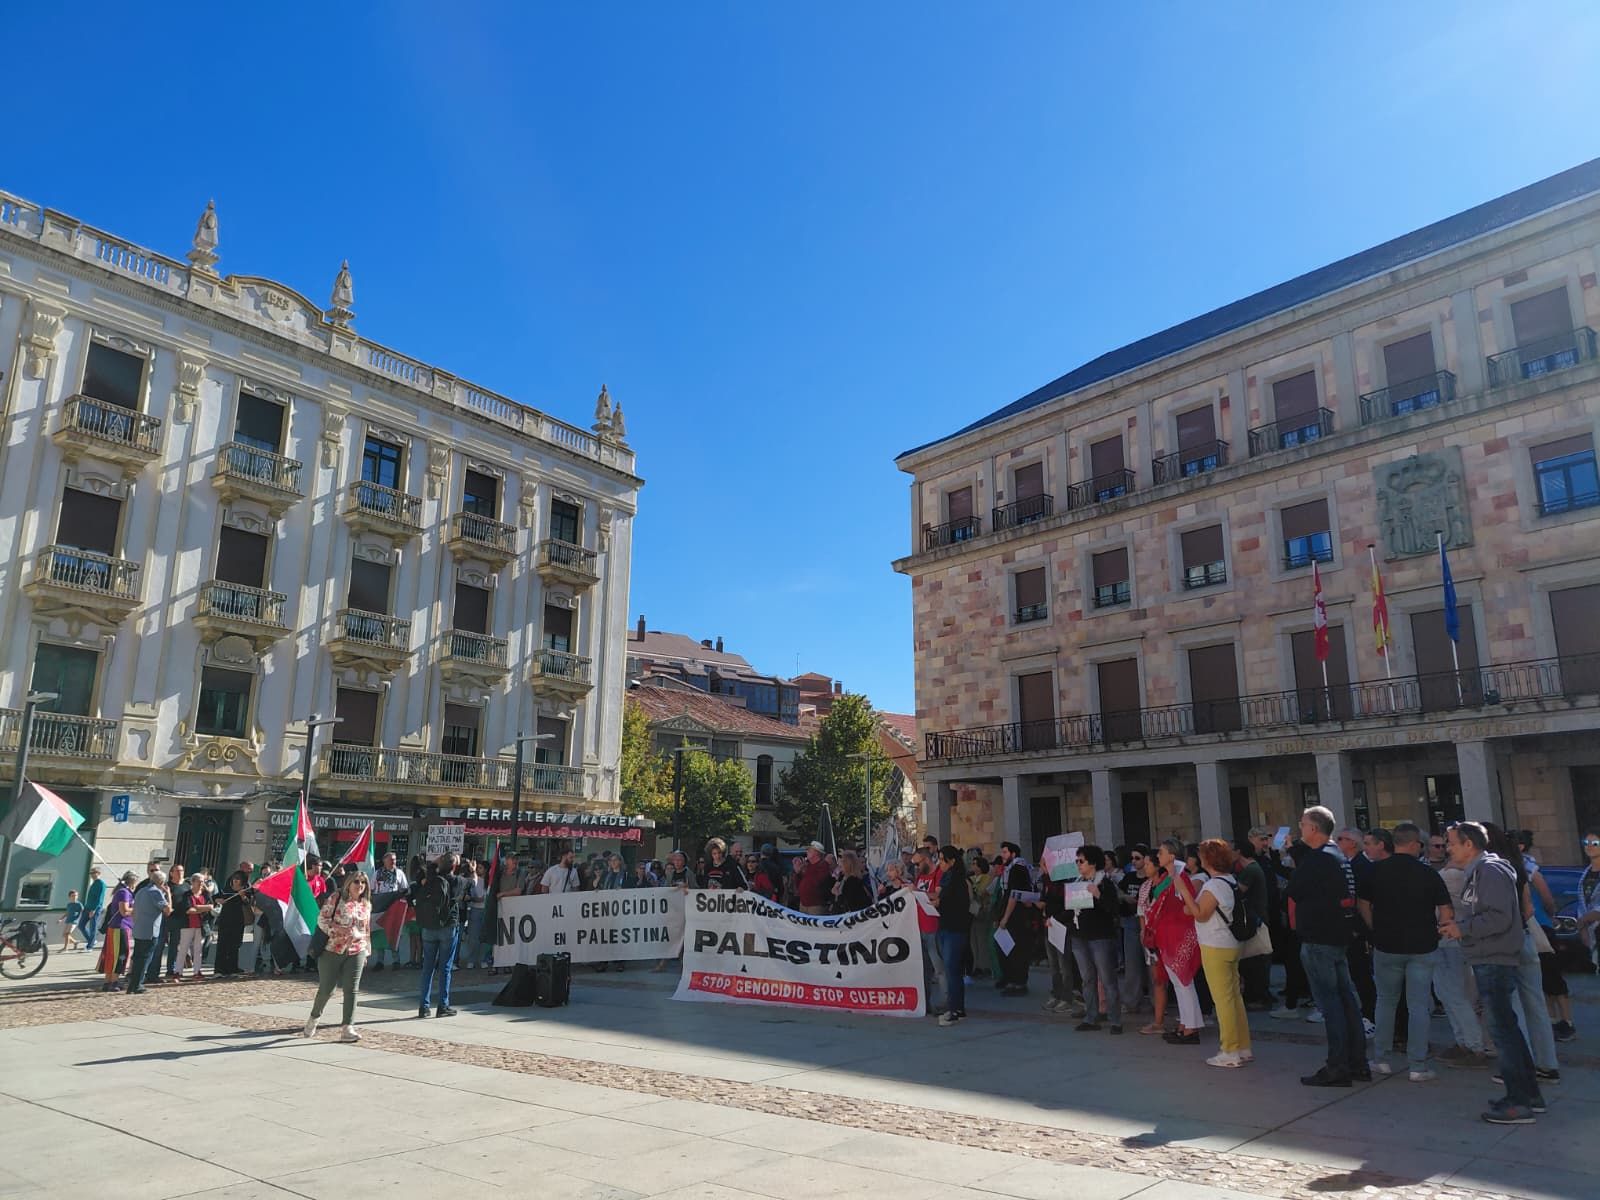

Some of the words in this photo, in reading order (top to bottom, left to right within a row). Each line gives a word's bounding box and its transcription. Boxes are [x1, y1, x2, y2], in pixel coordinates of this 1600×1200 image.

[315, 817, 329, 828] LOS
[552, 905, 565, 919] AL
[696, 892, 785, 920] Solidaridad
[787, 914, 819, 928] con
[823, 915, 841, 929] el
[843, 896, 907, 928] pueblo
[497, 914, 537, 946] NO
[554, 932, 566, 946] EN
[577, 926, 670, 945] PALESTINA
[694, 929, 910, 966] PALESTINO
[702, 975, 731, 990] STOP
[813, 989, 844, 1002] STOP
[850, 990, 905, 1005] GUERRA
